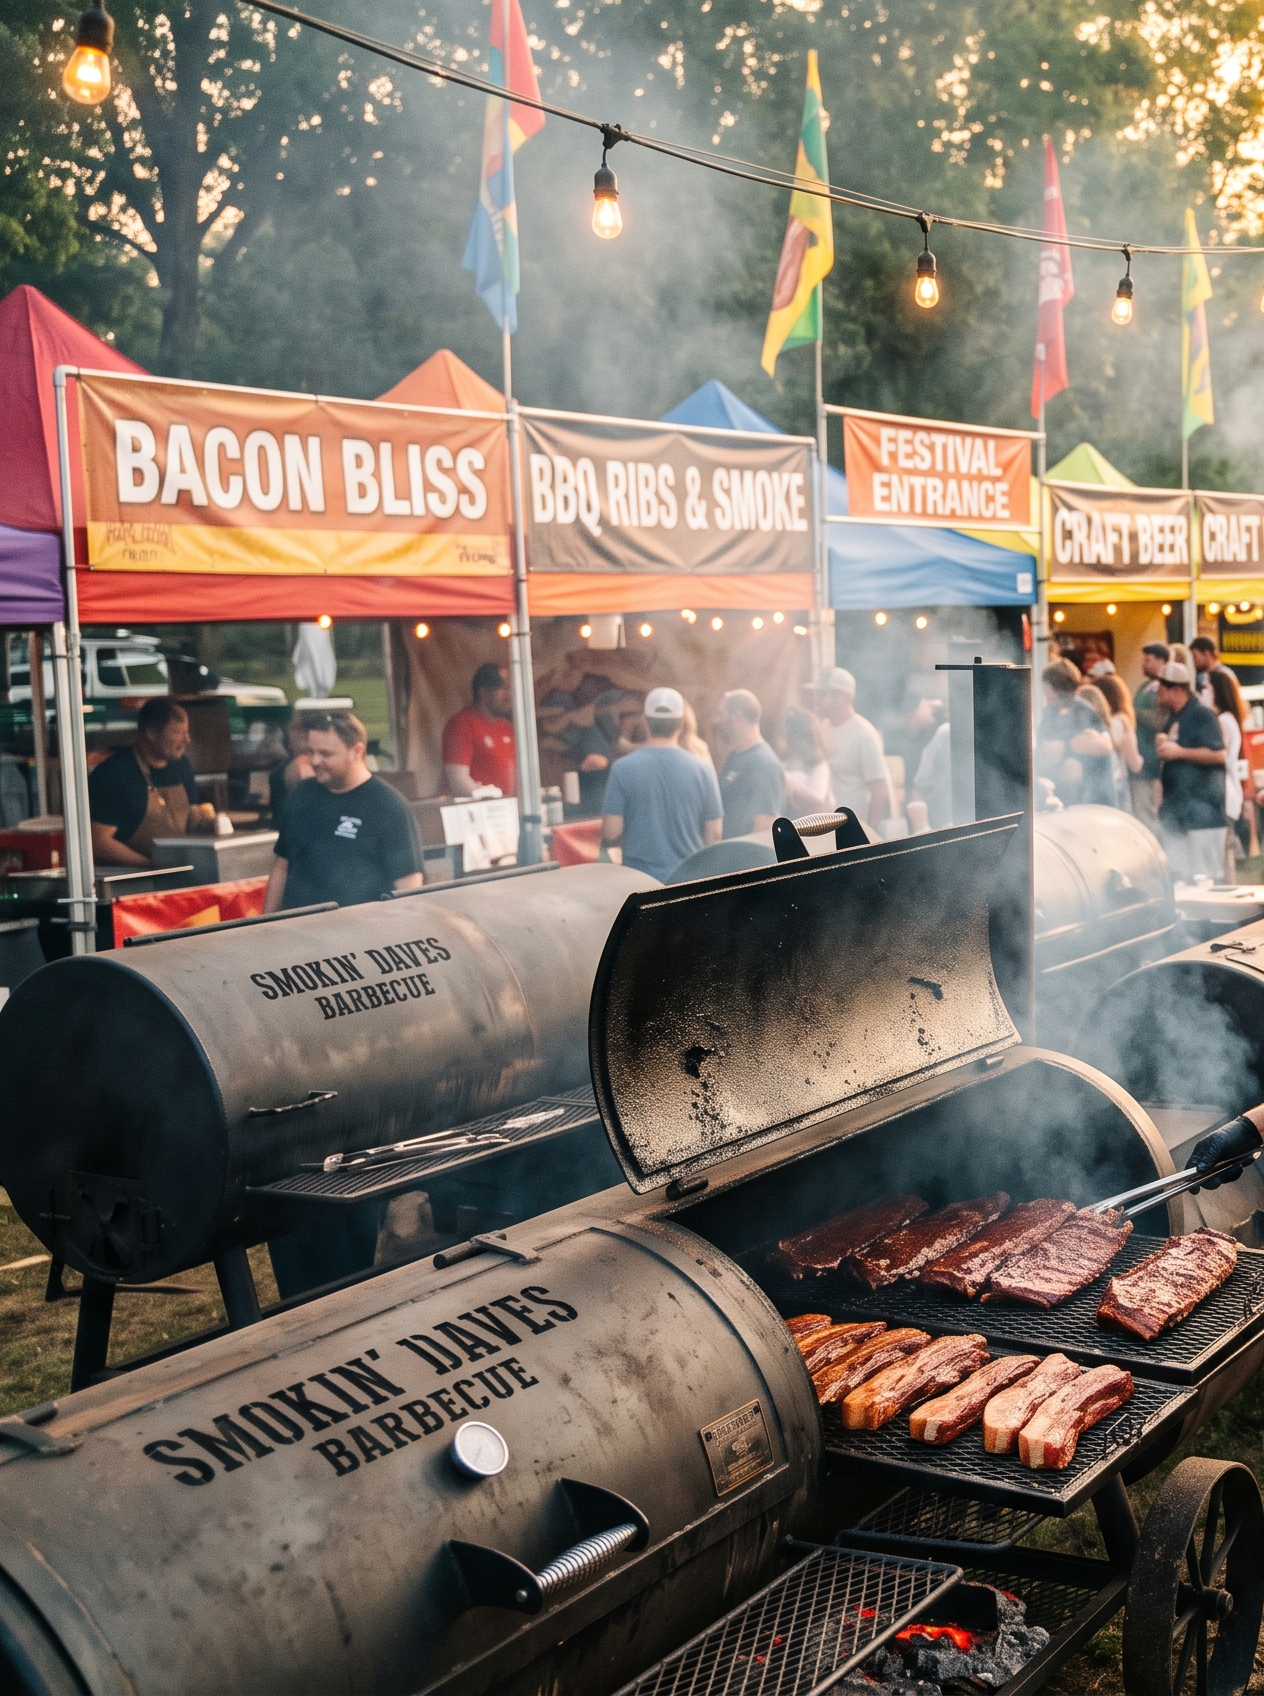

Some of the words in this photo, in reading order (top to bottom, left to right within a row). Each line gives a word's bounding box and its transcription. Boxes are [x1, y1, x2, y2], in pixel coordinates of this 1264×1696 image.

[114, 418, 325, 512] BACON
[342, 438, 488, 520] BLISS
[879, 426, 1003, 476] FESTIVAL
[529, 453, 602, 537] BBQ
[605, 460, 679, 530] RIBS
[684, 465, 709, 530] &
[712, 467, 808, 532] SMOKE
[872, 473, 1011, 519] ENTRANCE
[1053, 506, 1131, 564] CRAFT
[1137, 511, 1190, 565] BEER
[1202, 512, 1264, 564] CRAFT
[250, 952, 365, 1000] SMOKIN'
[364, 937, 452, 975] DAVES
[314, 973, 436, 1020] BARBECUE
[143, 1348, 407, 1487] SMOKIN'
[395, 1285, 580, 1376] DAVES
[311, 1357, 540, 1478] BARBECUE
